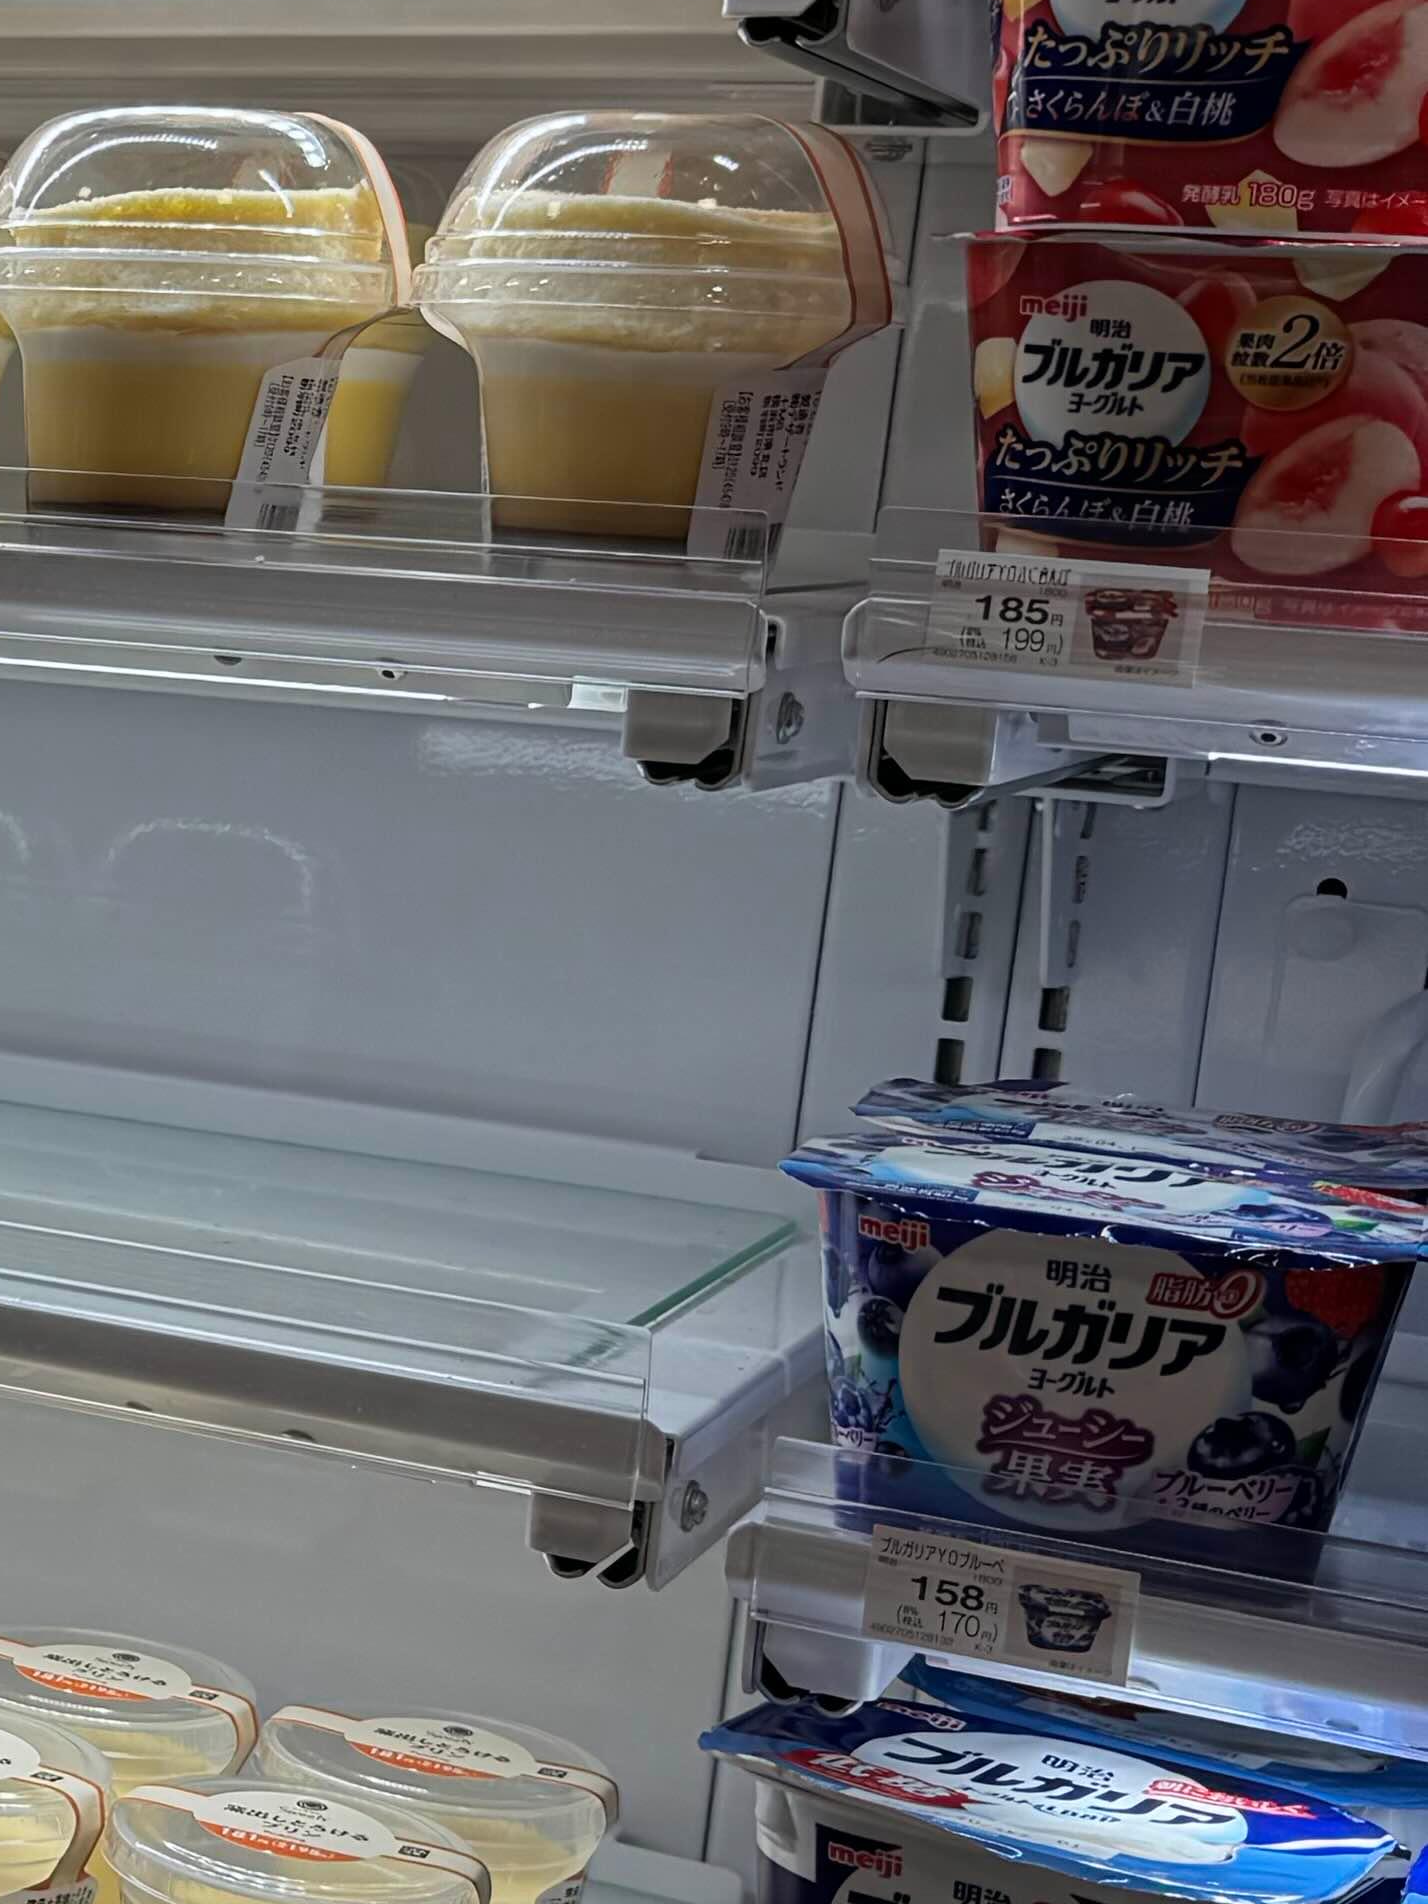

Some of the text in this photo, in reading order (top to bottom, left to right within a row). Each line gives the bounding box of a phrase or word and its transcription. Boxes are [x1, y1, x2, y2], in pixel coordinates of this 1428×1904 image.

[1023, 27, 1291, 77] たっぷりリッチ
[1025, 91, 1237, 128] さくらんぼ&白桃
[1181, 184, 1240, 206] 発酵乳
[1248, 183, 1315, 210] 180g
[1019, 295, 1089, 324] meiji
[1090, 319, 1131, 340] 明治
[1020, 340, 1206, 394] ブルガリア
[1066, 393, 1145, 418] ヨーグルト
[994, 428, 1245, 488] たっぷりリッチ
[857, 1213, 932, 1254] meiji
[1046, 1259, 1113, 1293] 明治
[933, 1283, 1228, 1378] ブルガリア
[1027, 1369, 1116, 1399] ヨーグルト
[983, 1397, 1148, 1452] ジューシー
[999, 1450, 1117, 1509] 果実
[1154, 1469, 1296, 1500] ブルーベリー
[883, 1735, 1250, 1829] ブルガリア
[1039, 1752, 1118, 1785] 明治
[826, 1841, 904, 1881] meiji
